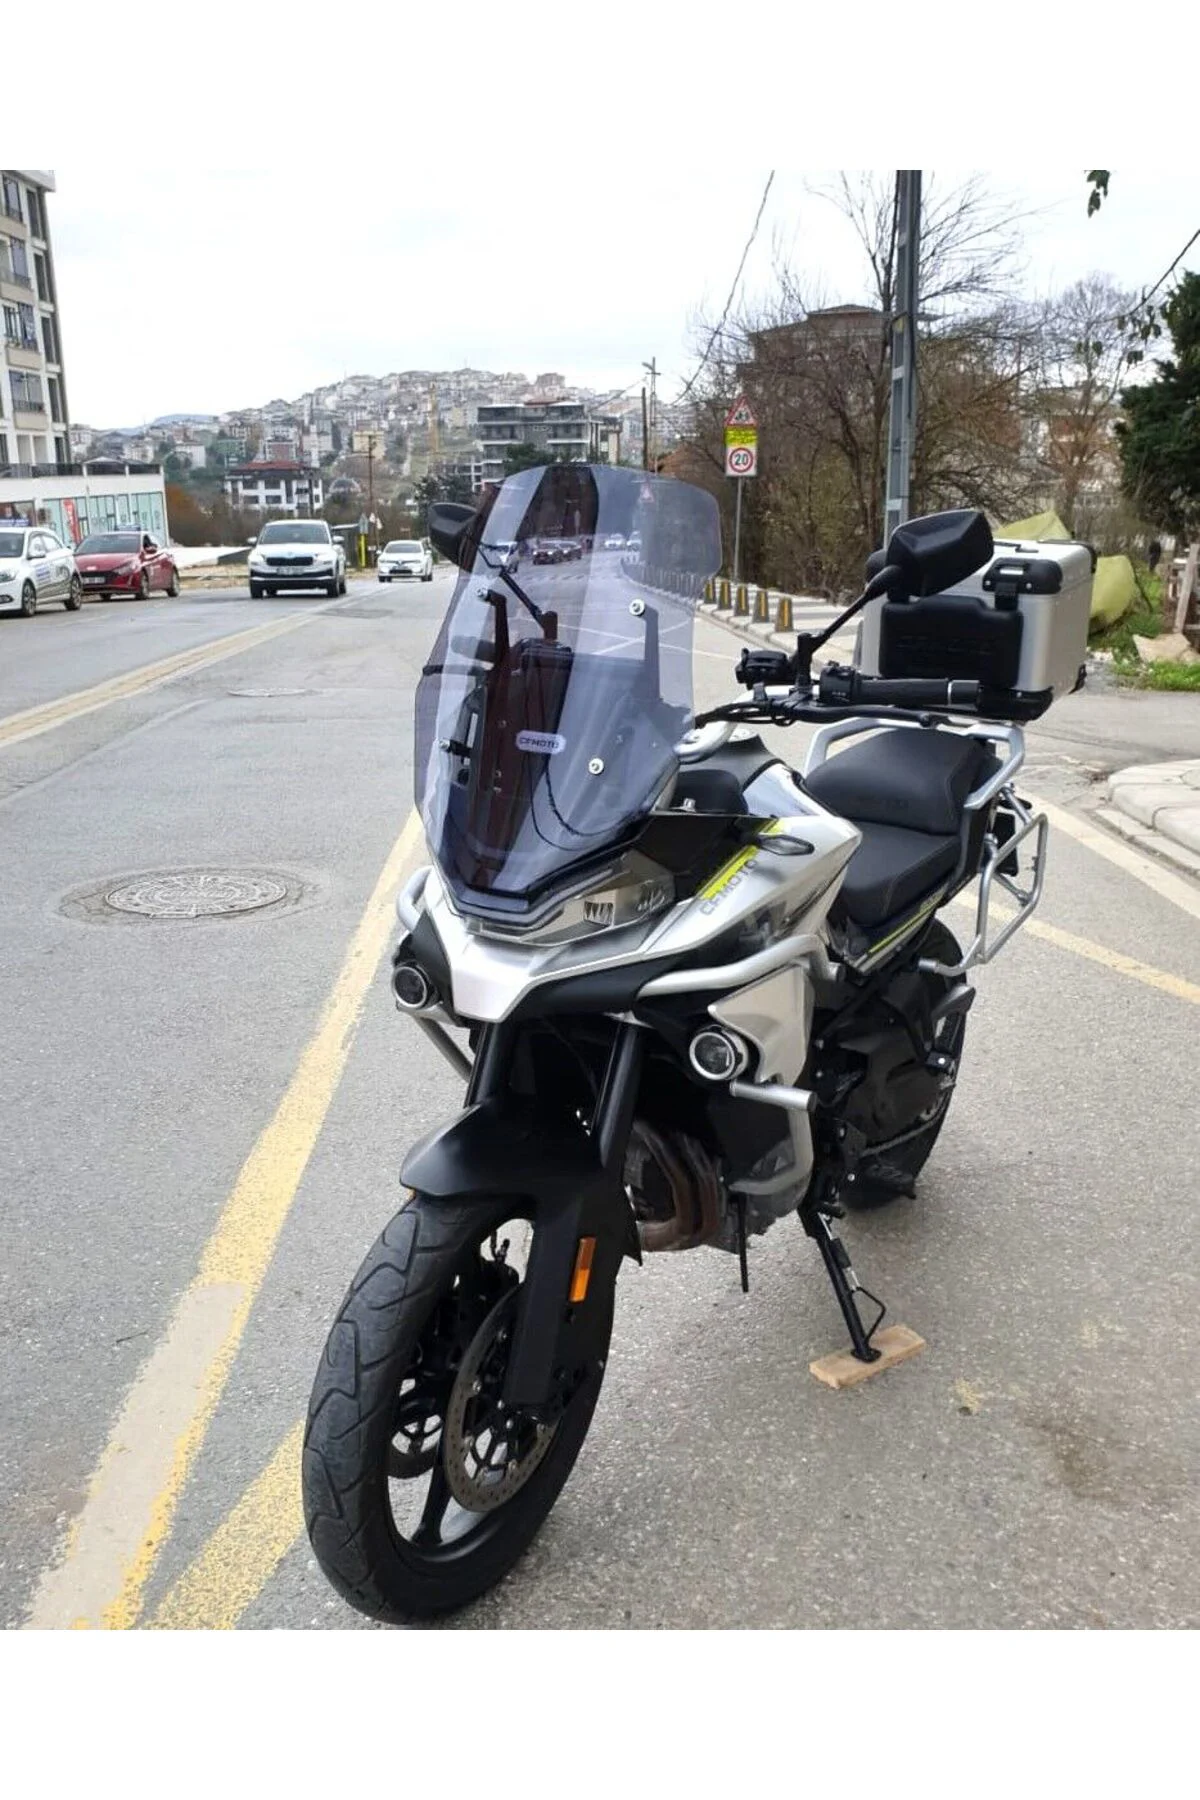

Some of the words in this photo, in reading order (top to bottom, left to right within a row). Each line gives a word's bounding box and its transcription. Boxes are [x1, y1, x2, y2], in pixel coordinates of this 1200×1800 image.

[734, 453, 748, 466] 20
[519, 736, 560, 750] CFMOTO
[700, 859, 757, 916] CFMOTO
